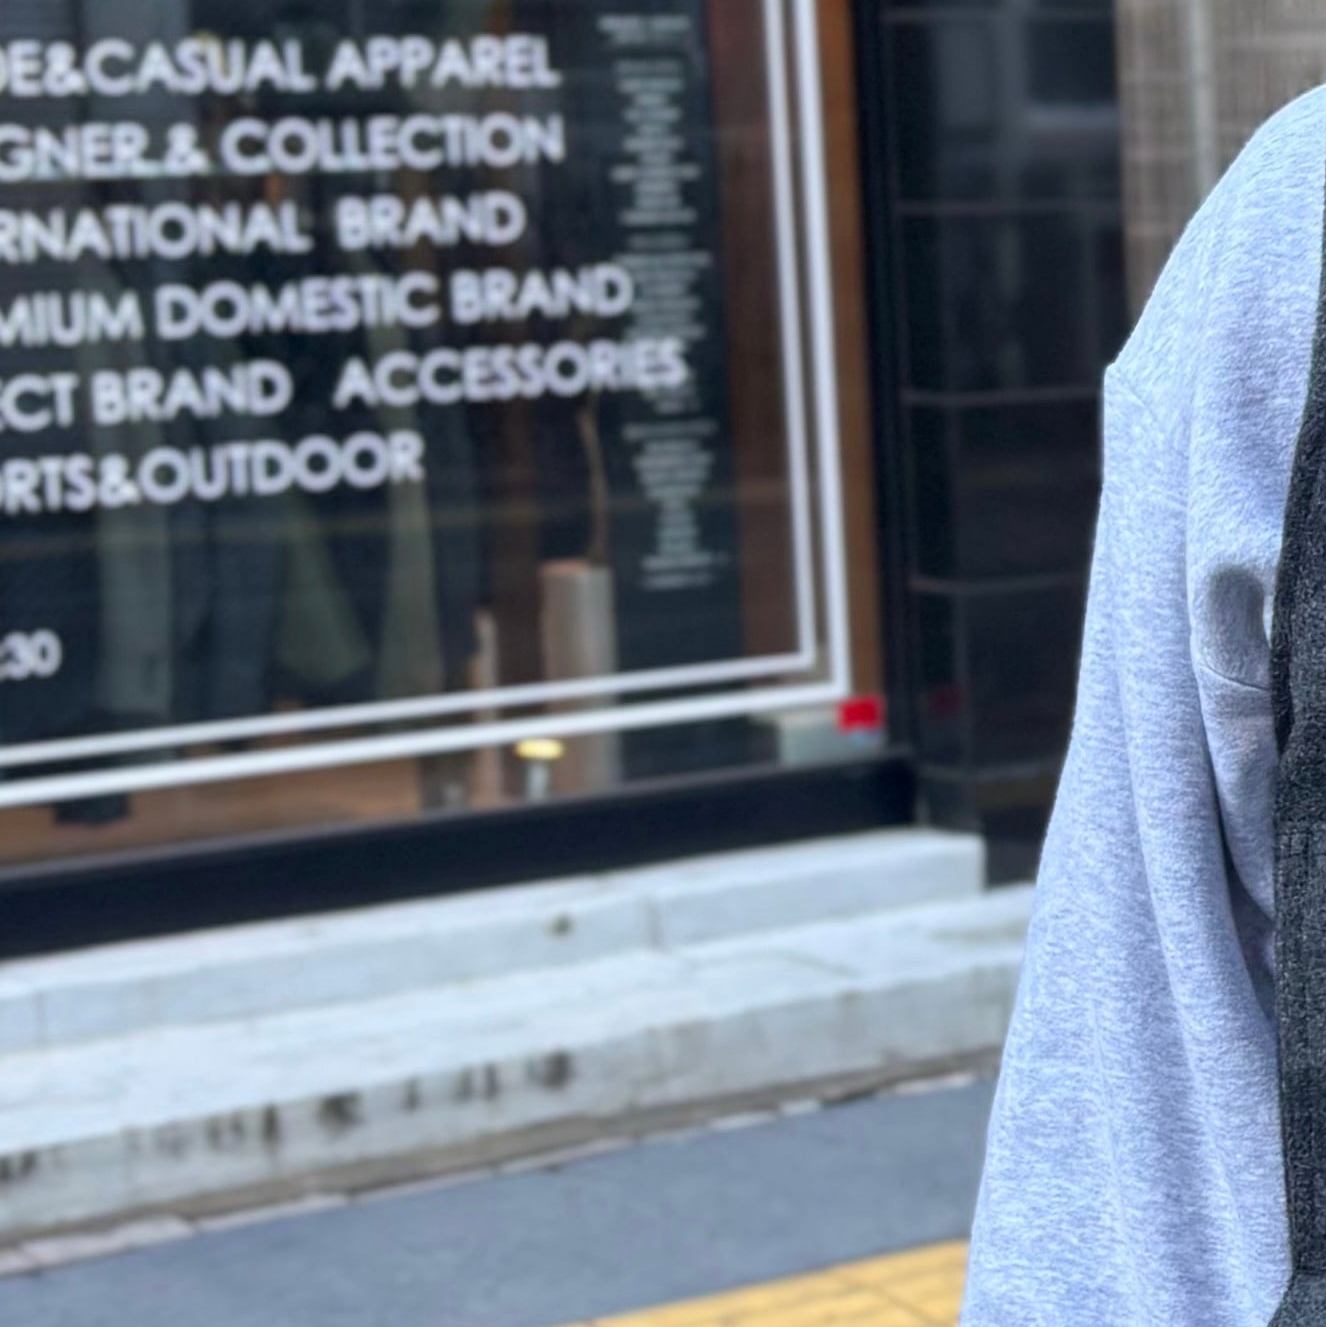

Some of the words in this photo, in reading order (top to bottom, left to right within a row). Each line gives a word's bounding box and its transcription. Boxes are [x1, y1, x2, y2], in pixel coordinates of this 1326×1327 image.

[0, 37, 314, 97] E&CASUAL
[327, 34, 560, 90] APPAREL
[220, 113, 565, 175] COLLECTION
[336, 191, 525, 250] BRAND
[155, 280, 440, 339] DOMESTIC
[451, 264, 634, 323] BRAND
[0, 370, 79, 431] CT
[92, 359, 292, 426] BRAND
[334, 338, 689, 406] ACCESSORIES
[0, 431, 424, 513] RTS&OUTDOOR
